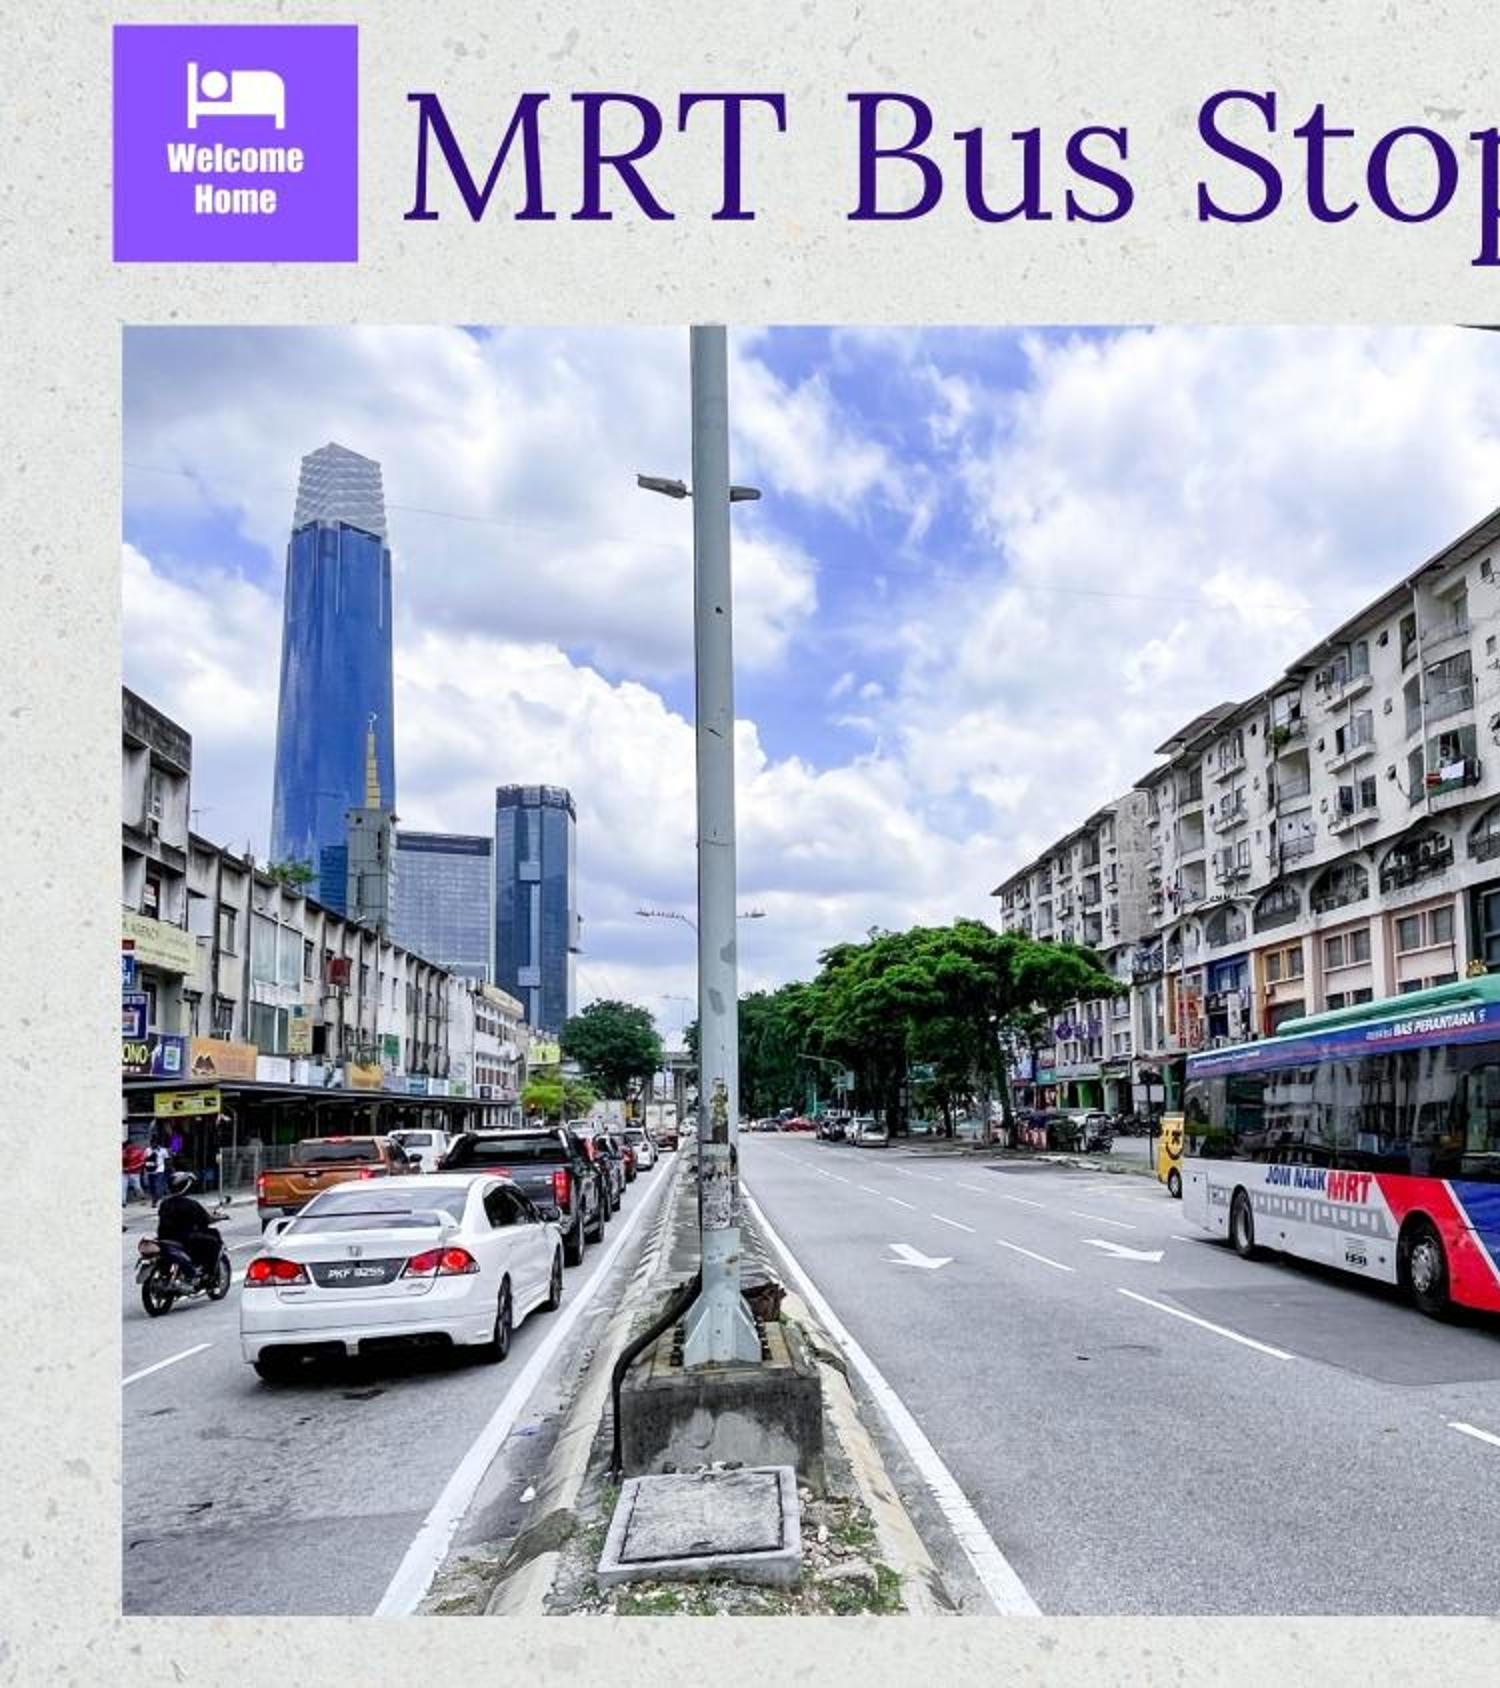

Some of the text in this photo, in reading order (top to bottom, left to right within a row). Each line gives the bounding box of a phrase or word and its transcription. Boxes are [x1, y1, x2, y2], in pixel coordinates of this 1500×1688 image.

[1265, 1165, 1374, 1204] JOM NAIK MRT
